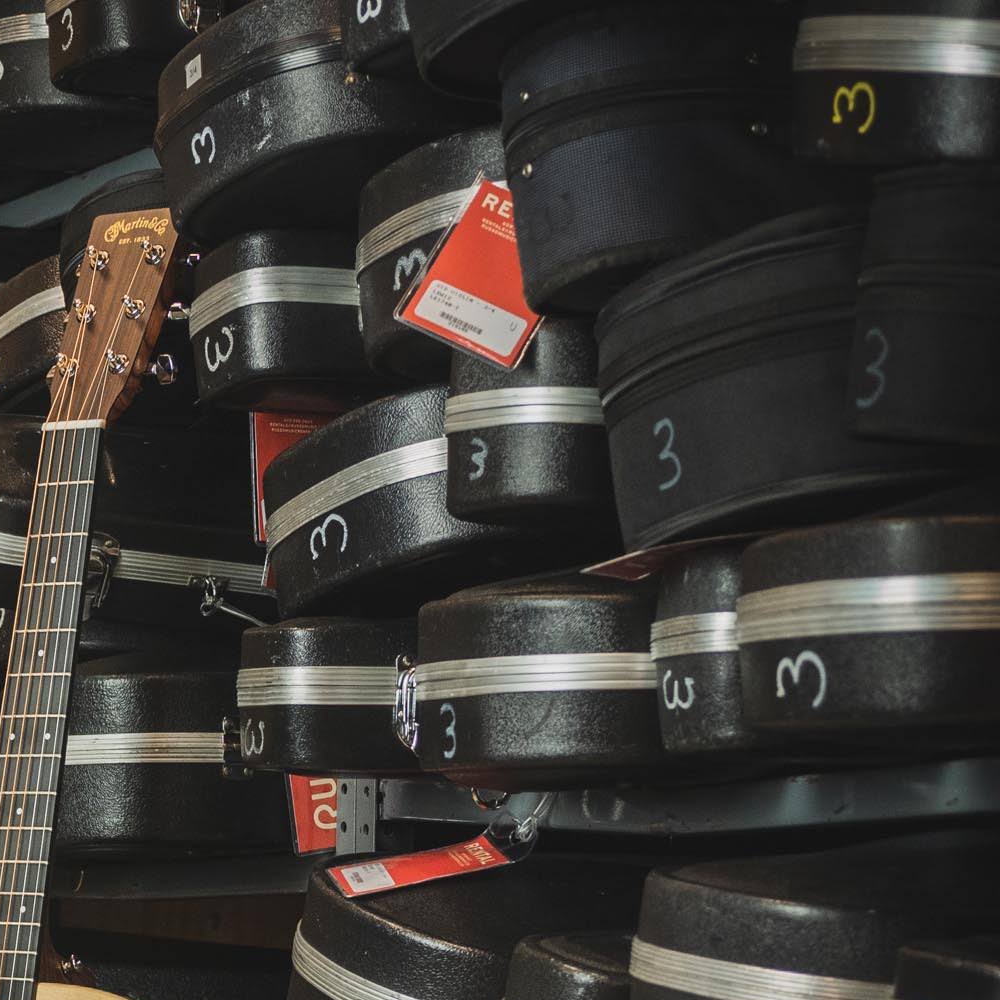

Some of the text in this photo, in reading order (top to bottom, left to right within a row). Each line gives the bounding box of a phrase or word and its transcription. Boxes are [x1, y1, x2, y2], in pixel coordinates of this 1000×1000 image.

[61, 8, 74, 51] 3
[357, 0, 381, 24] 3
[832, 82, 875, 134] 3
[191, 126, 216, 164] 3
[394, 247, 426, 291] 3
[205, 326, 235, 372] 3
[855, 328, 888, 408] 3
[470, 438, 487, 480] 3
[653, 418, 682, 491] 3
[310, 514, 347, 560] 3
[663, 669, 695, 709] 3
[776, 650, 826, 708] 3
[243, 719, 264, 756] 3
[440, 704, 456, 759] 3
[464, 842, 495, 865] RENTAL
